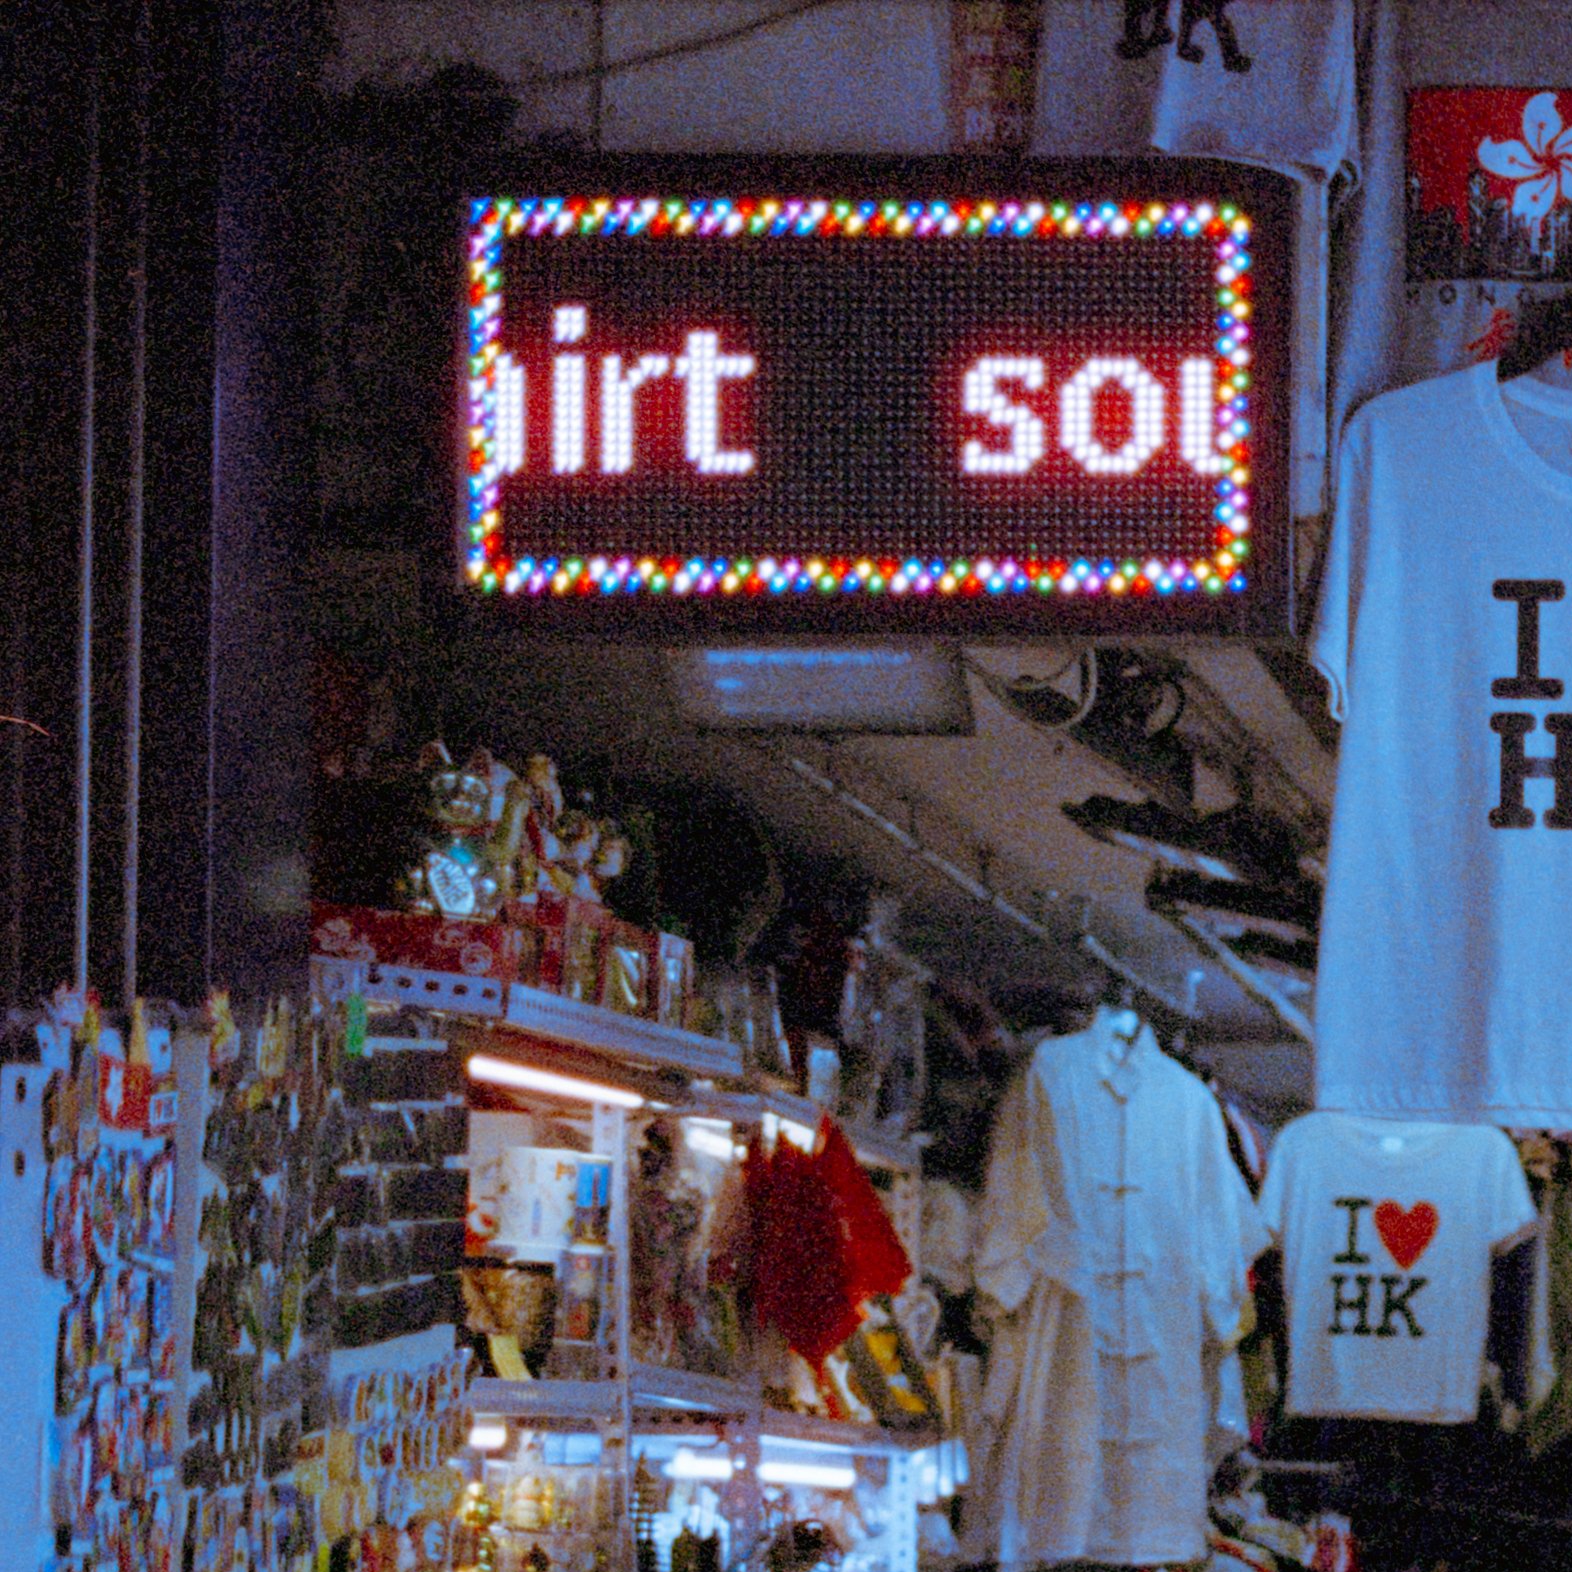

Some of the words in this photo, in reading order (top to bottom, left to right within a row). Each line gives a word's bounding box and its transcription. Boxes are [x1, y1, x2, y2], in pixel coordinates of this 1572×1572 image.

[1490, 578, 1566, 700] I
[1332, 1196, 1373, 1264] I
[1328, 1273, 1428, 1338] HK
